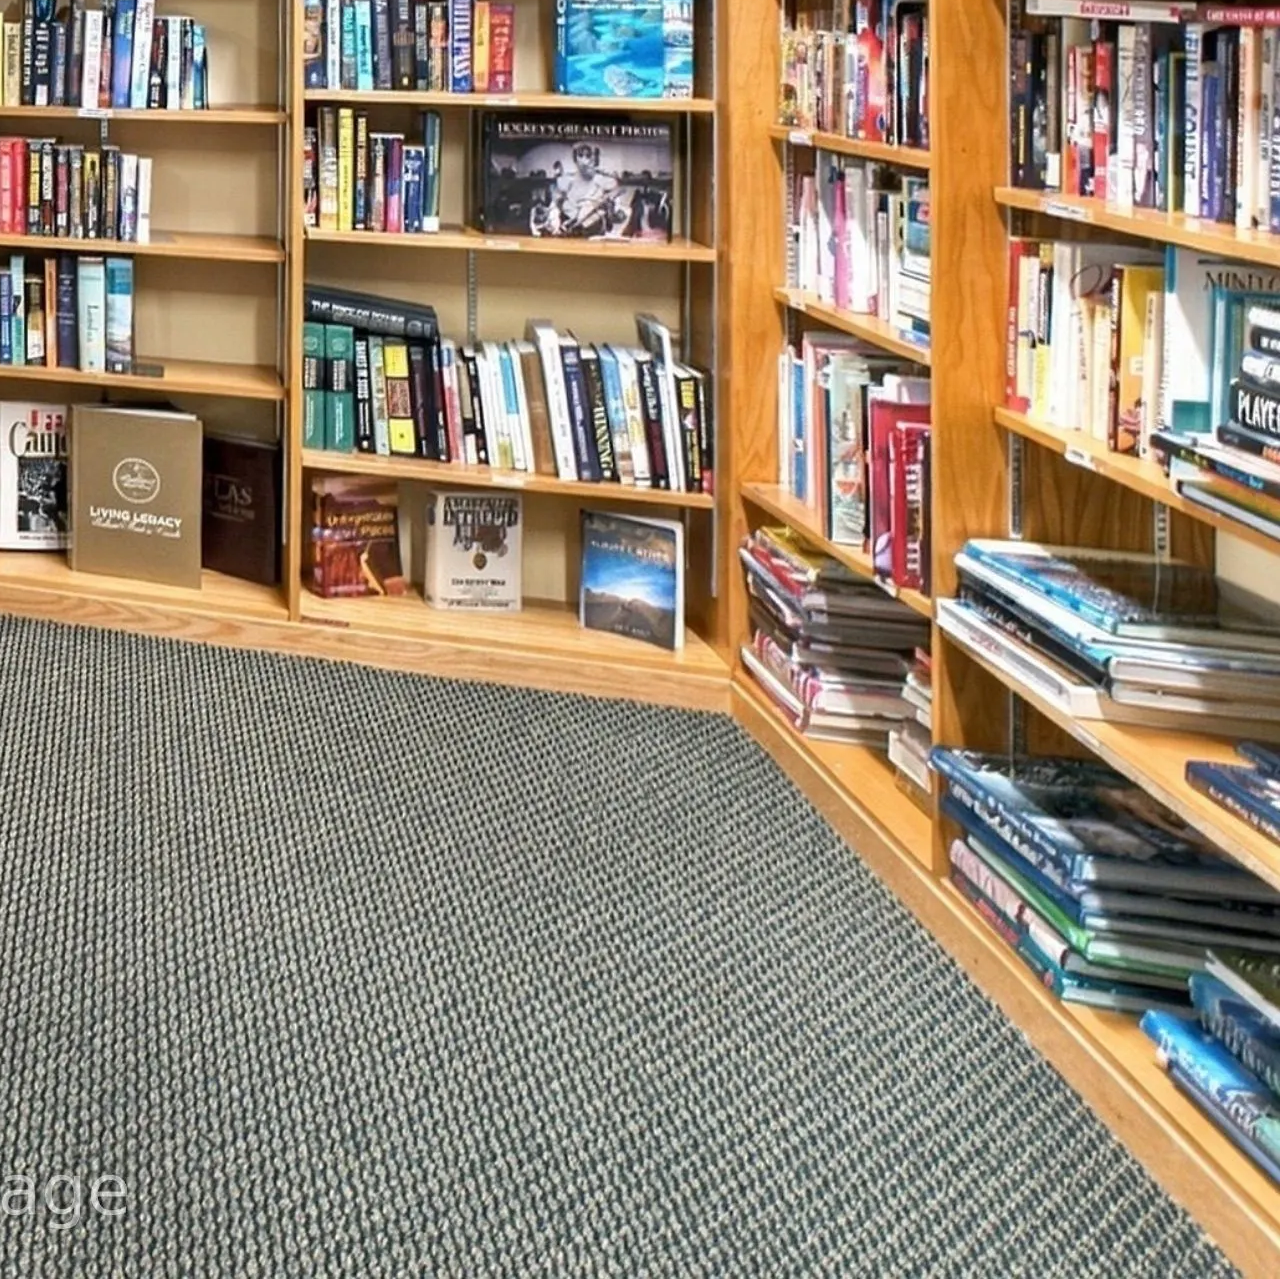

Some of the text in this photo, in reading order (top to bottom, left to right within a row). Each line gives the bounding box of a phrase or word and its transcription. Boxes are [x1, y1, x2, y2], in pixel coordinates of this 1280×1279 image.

[1238, 389, 1280, 435] PLAYE
[89, 506, 183, 529] LIVING LEGACY
